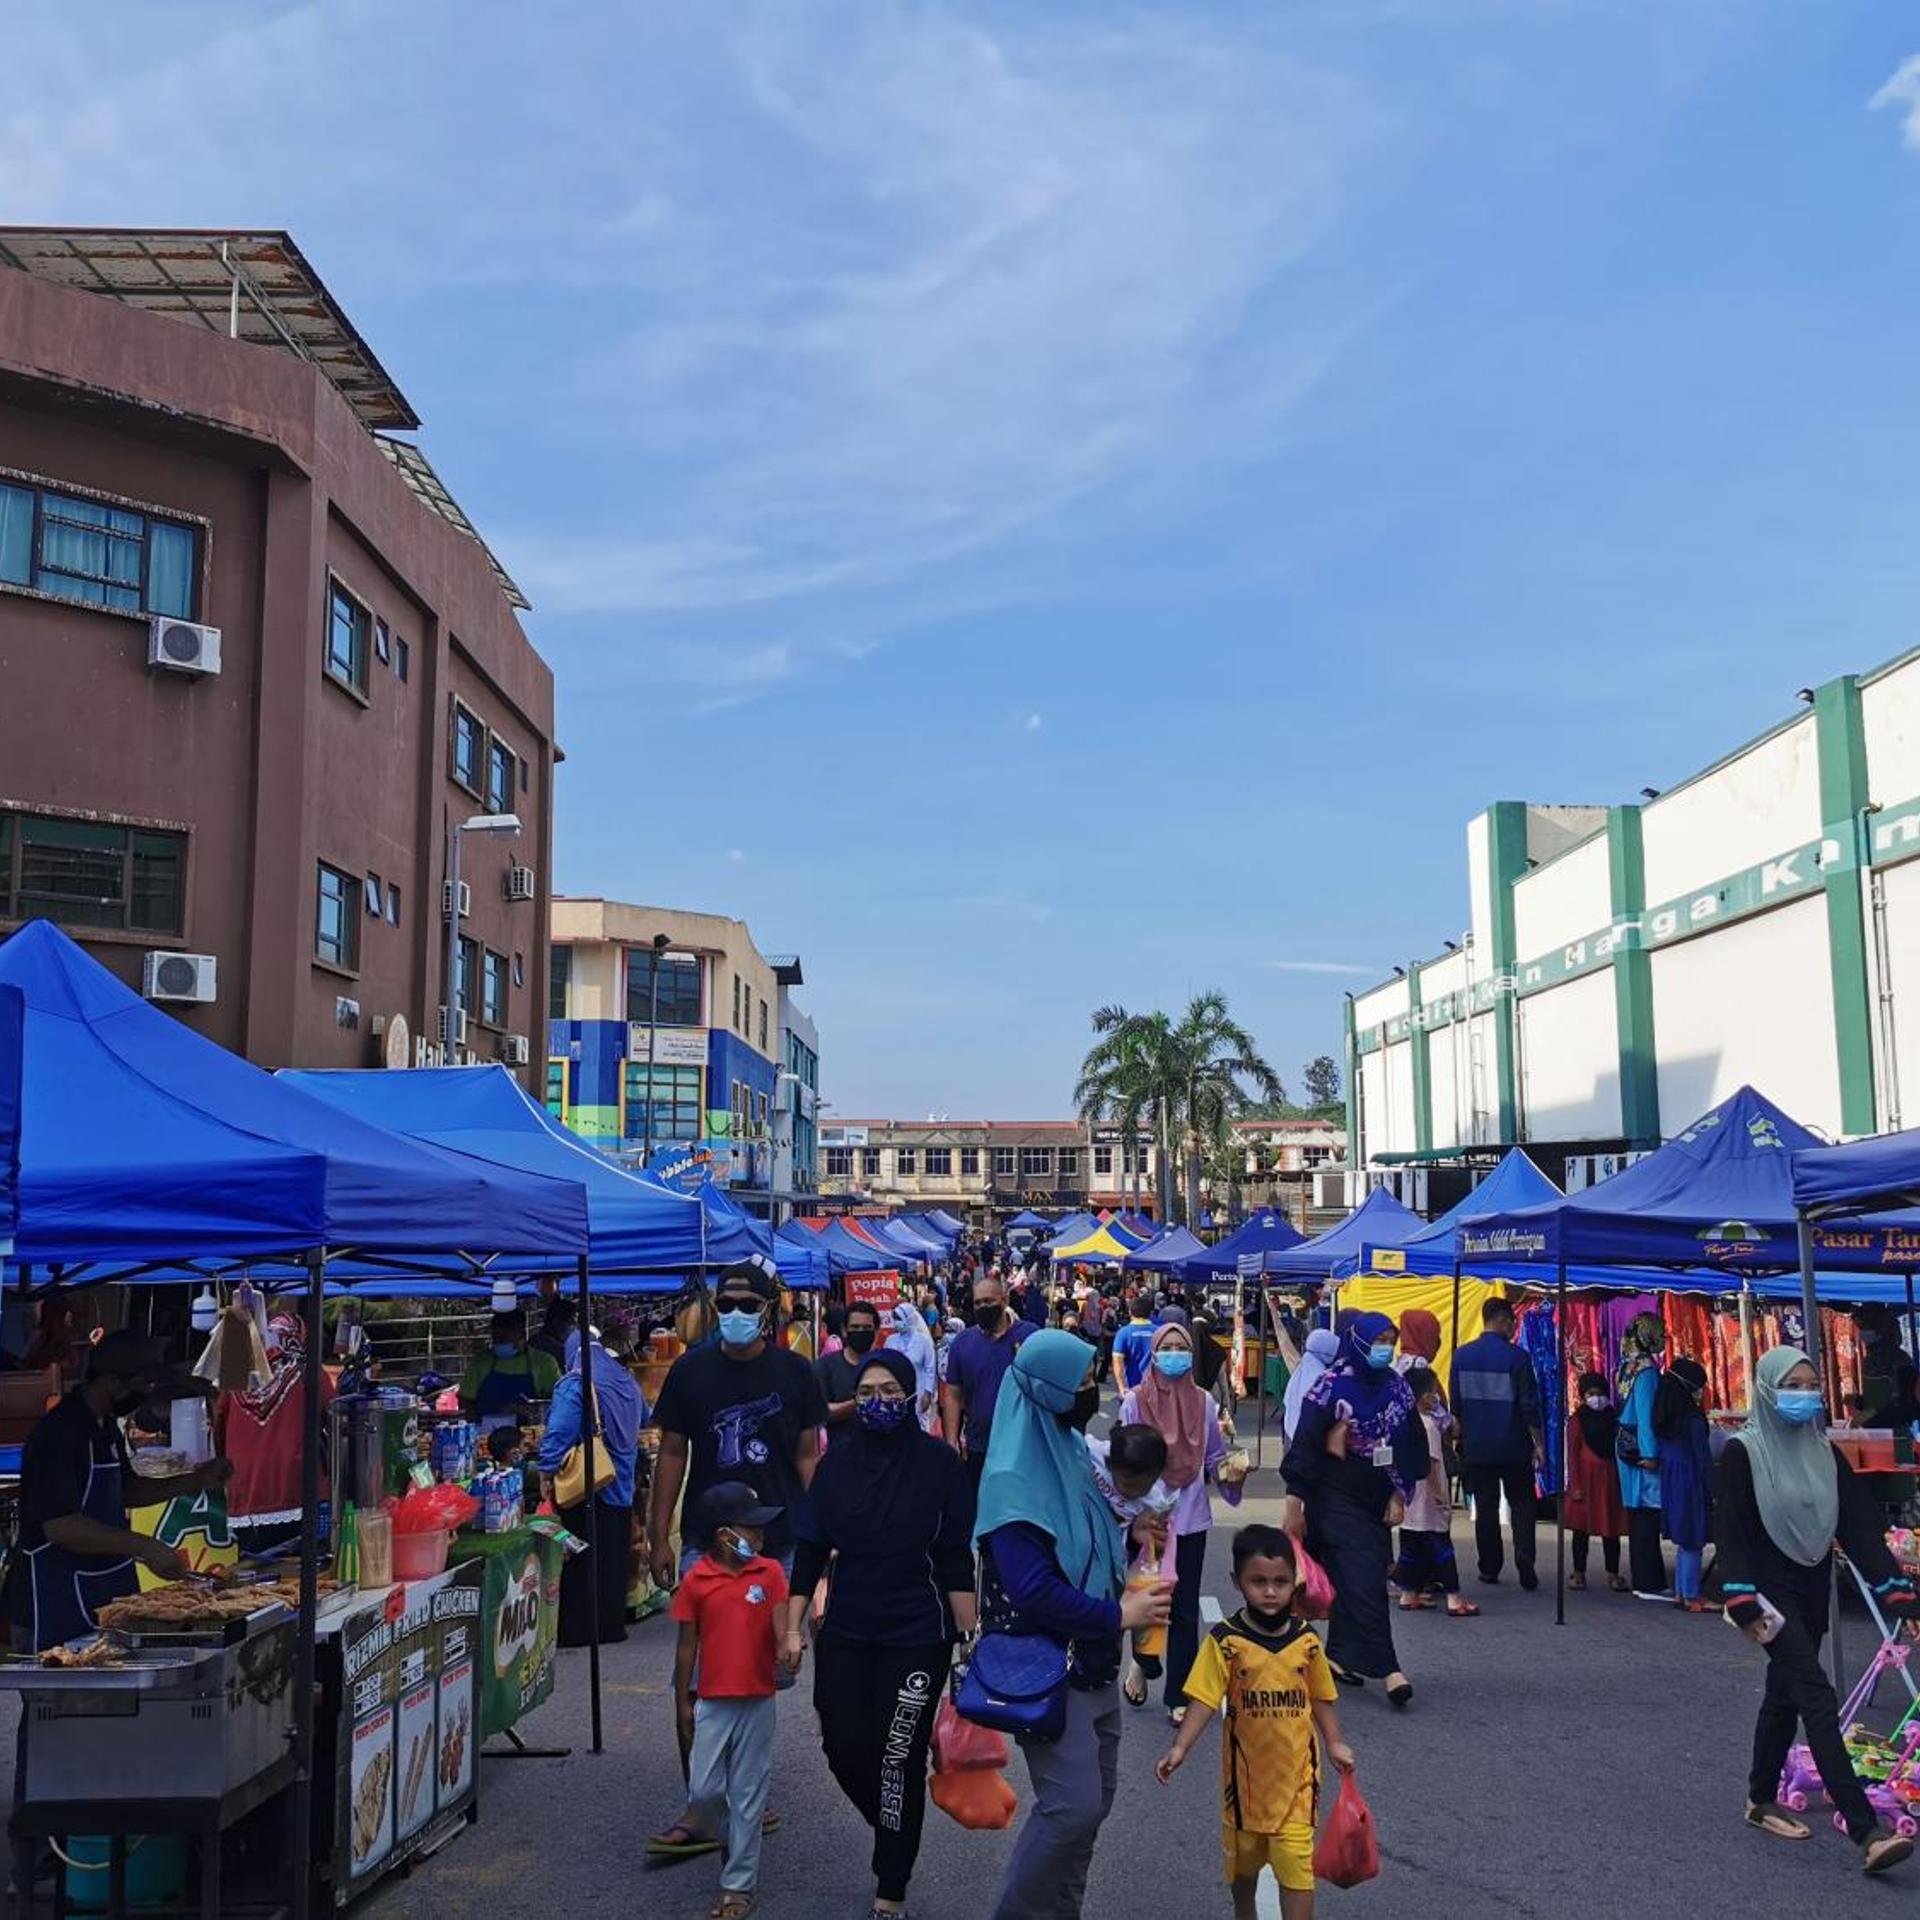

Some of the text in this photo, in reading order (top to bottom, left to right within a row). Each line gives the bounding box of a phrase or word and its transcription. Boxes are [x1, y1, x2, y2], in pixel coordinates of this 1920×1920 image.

[1564, 893, 1719, 970] Harga
[1810, 1227, 1873, 1248] Pasar
[433, 1588, 480, 1619] CHICKEN
[1242, 1687, 1306, 1710] HARIMAU
